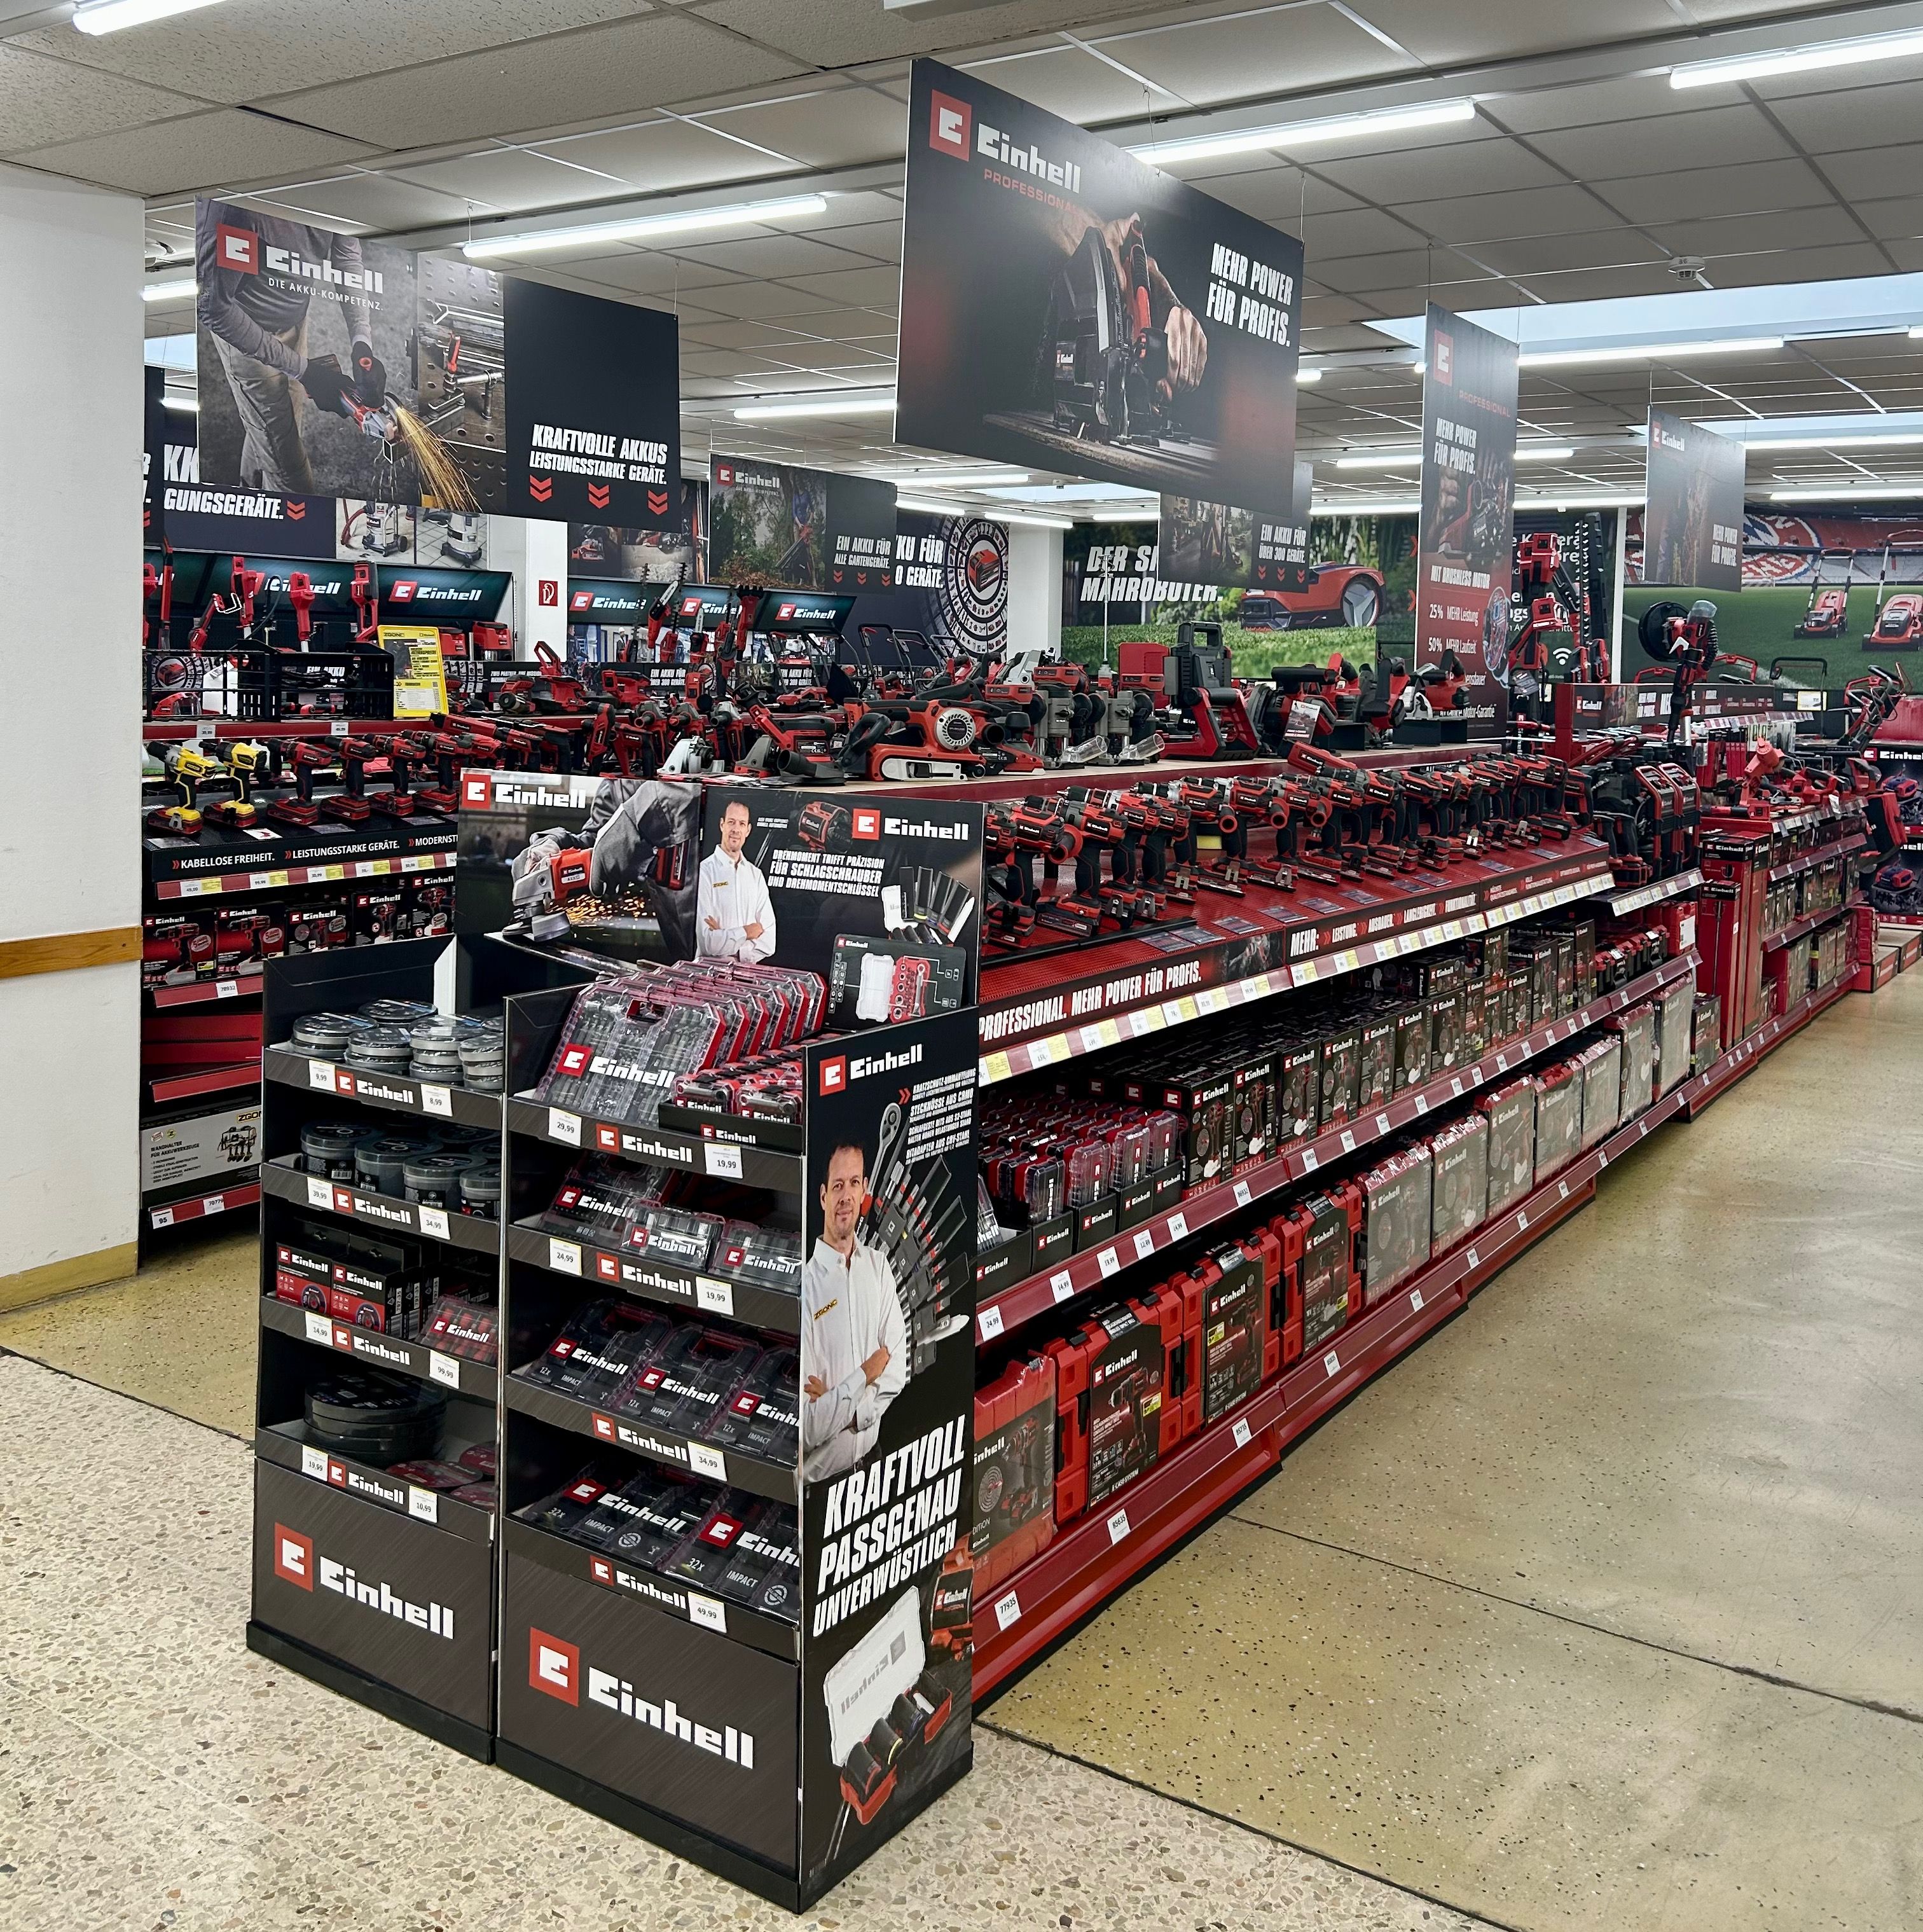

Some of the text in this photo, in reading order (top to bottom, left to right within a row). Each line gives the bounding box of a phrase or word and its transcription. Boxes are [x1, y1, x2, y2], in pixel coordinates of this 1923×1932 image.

[977, 123, 1080, 193] Einhell
[266, 245, 383, 293] Einhell
[1211, 243, 1293, 306] MEHR POWER
[268, 277, 383, 312] DIE AKKU-KOMPETENZ.
[1206, 280, 1290, 347] FÜR PROFIS.
[1459, 390, 1510, 417] PROFESSIONAL
[1436, 417, 1477, 449] MEHR POWER
[1662, 431, 1685, 451] Einhell
[532, 424, 668, 465] KRAFTVOLLE AKKUS
[1433, 439, 1475, 474] FÜR PROFIS.
[529, 450, 668, 485] LEISTUNGSSTARKE GERÄTE.
[735, 471, 780, 488] Einhell
[836, 535, 891, 555] EIN AKKU FÜR
[1260, 524, 1306, 546] EIN AKKU FÜR
[919, 534, 944, 563] FÜR
[1087, 545, 1127, 572] DER
[1258, 542, 1306, 563] ÜBER 300 GERÄTE.
[834, 553, 890, 569] ALLE GARTENGERÄTE.
[906, 567, 944, 589] GERÄTE.
[417, 587, 483, 601] Einhell
[794, 609, 836, 619] Einhell
[1430, 604, 1460, 621] 25% MEHR
[1428, 637, 1442, 652] 50%
[495, 784, 586, 809] Einhell
[884, 817, 969, 841] Einhell
[292, 839, 400, 859] LEISTUNGSSTARKE GERÄTE.
[181, 852, 275, 869] KABELLOSE FREIHEIT.
[773, 850, 885, 869] DREHMOMENT TRIFFT PRÄZISION
[424, 876, 453, 885] Einhell
[769, 860, 882, 884] FÜR SCHLAGSCHRAUBER
[768, 876, 879, 897] UND DREHMOMENTSCHLÜSSEL
[370, 894, 401, 903] Einhell
[155, 916, 185, 925] Einhell
[303, 910, 336, 920] Einhell
[845, 940, 869, 948] Einhell
[1290, 923, 1357, 957] MEHR: LEISTUNG.
[1437, 965, 1454, 977] Einhell
[979, 960, 1201, 1042] PROFESSIONAL. MEHR POWER FÜR PROFIS.
[1438, 998, 1456, 1011] Einhell
[1405, 1012, 1422, 1025] Einhell
[1370, 1025, 1389, 1038] Einhell
[1332, 1038, 1353, 1052] Einhell
[850, 1043, 923, 1080] Einhell
[1292, 1050, 1314, 1066] Einhell
[589, 1056, 675, 1088] Einhell
[1244, 1065, 1269, 1082] Einhell
[357, 1080, 414, 1103] Einhell
[429, 1097, 442, 1106] 8,99
[1203, 1083, 1229, 1101] Einhell
[911, 1088, 974, 1117] STECKNÜSSE AUS CRMO
[1498, 1103, 1519, 1124] Einhell
[557, 1121, 575, 1133] 29,99
[715, 1129, 756, 1144] Einhell
[623, 1135, 693, 1163] Einhell
[906, 1137, 945, 1159] BITADAPTER AUS
[717, 1159, 736, 1169] 19,99
[1445, 1149, 1467, 1170] Einhell
[1162, 1173, 1181, 1188] Einhell
[1131, 1191, 1150, 1207] Einhell
[1378, 1185, 1400, 1206] Einhell
[354, 1198, 411, 1224] Einhell
[1091, 1209, 1113, 1225] Einhell
[426, 1219, 441, 1230] 34,99
[647, 1236, 696, 1255] Einhell
[1046, 1228, 1069, 1244] Einhell
[1313, 1226, 1334, 1246] Einhell
[292, 1254, 328, 1273] Einhell
[556, 1252, 574, 1263] 24,99
[984, 1257, 1008, 1274] Einhell
[347, 1272, 382, 1290] Einhell
[622, 1264, 691, 1295] Einhell
[706, 1292, 726, 1302] 19,99
[1220, 1284, 1246, 1307] Einhell
[313, 1327, 327, 1336] 14,99
[986, 1317, 999, 1328] 24,99
[446, 1324, 489, 1343] Einhell
[354, 1335, 410, 1365] Einhell
[572, 1348, 628, 1375] Einhell
[1105, 1349, 1138, 1377] Einhell
[562, 1374, 581, 1386] IMPACT
[661, 1377, 720, 1404] Einhell
[651, 1406, 672, 1418] IMPACT
[618, 1426, 687, 1461] Einhell
[748, 1432, 771, 1445] IMPACT
[308, 1460, 323, 1472] 19,99
[699, 1456, 717, 1468] 34,99
[824, 1414, 967, 1539] KRAFTVOLL
[348, 1472, 404, 1505] Einhell
[597, 1493, 687, 1533] Einhell
[1112, 1514, 1126, 1529] 85635
[585, 1518, 614, 1533] IMPACT
[817, 1468, 962, 1596] PASSGENAU
[726, 1570, 758, 1588] IMPACT
[813, 1518, 957, 1638] UNVERWÜSTLICH
[320, 1556, 453, 1639] Einhell
[616, 1570, 686, 1610] Einhell
[697, 1607, 717, 1619] 49,99
[999, 1596, 1016, 1615] 77935
[588, 1666, 754, 1769] Einhell
